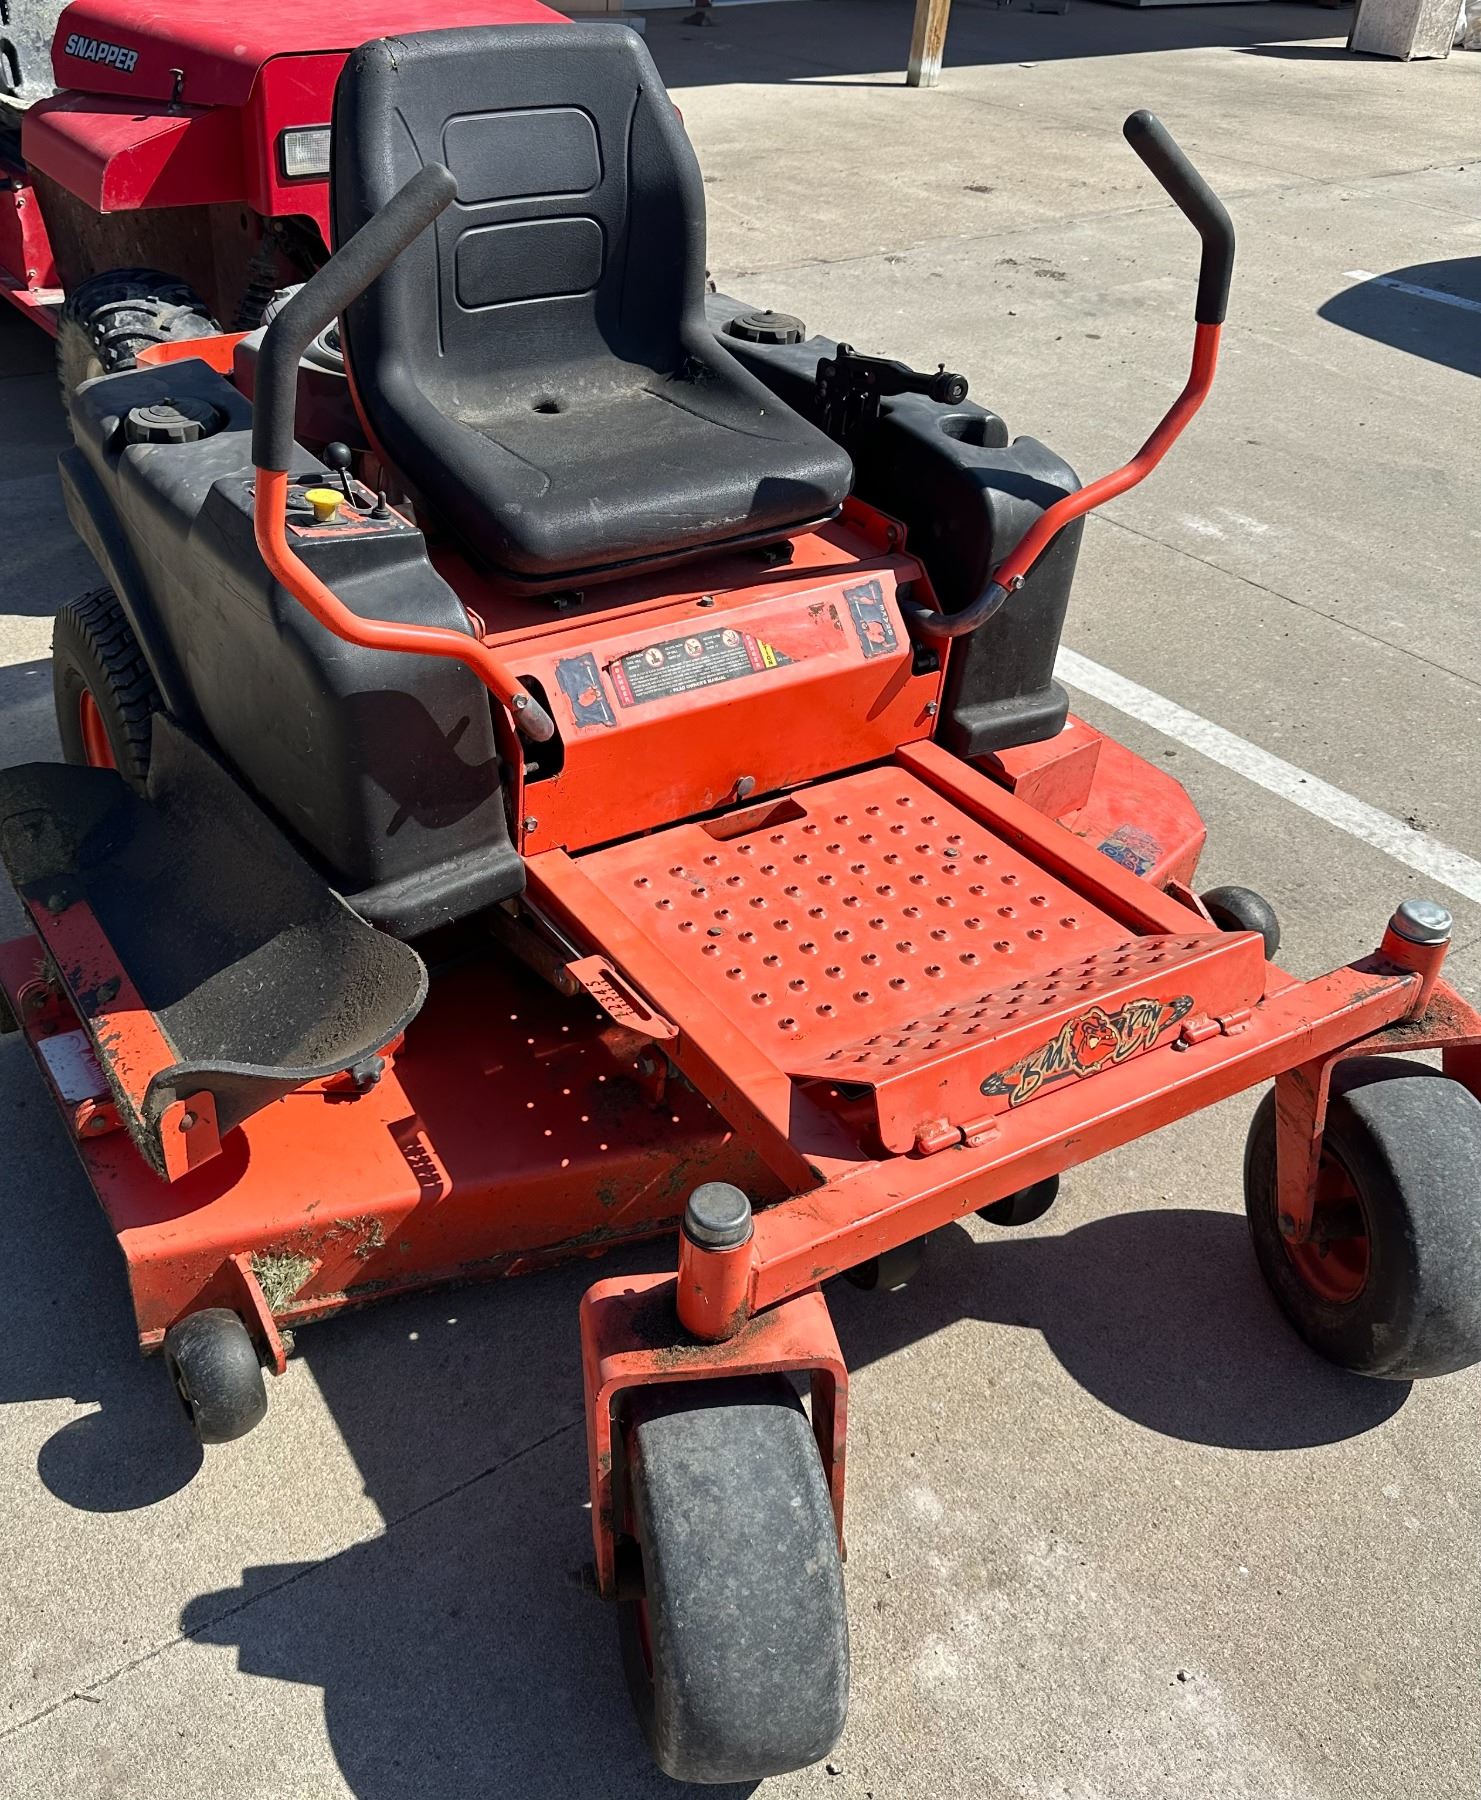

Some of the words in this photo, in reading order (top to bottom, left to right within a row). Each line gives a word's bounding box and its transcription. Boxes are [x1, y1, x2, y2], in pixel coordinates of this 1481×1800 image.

[64, 33, 139, 72] SNAPPER
[880, 604, 894, 636] BRAKE
[614, 667, 631, 703] DANGER
